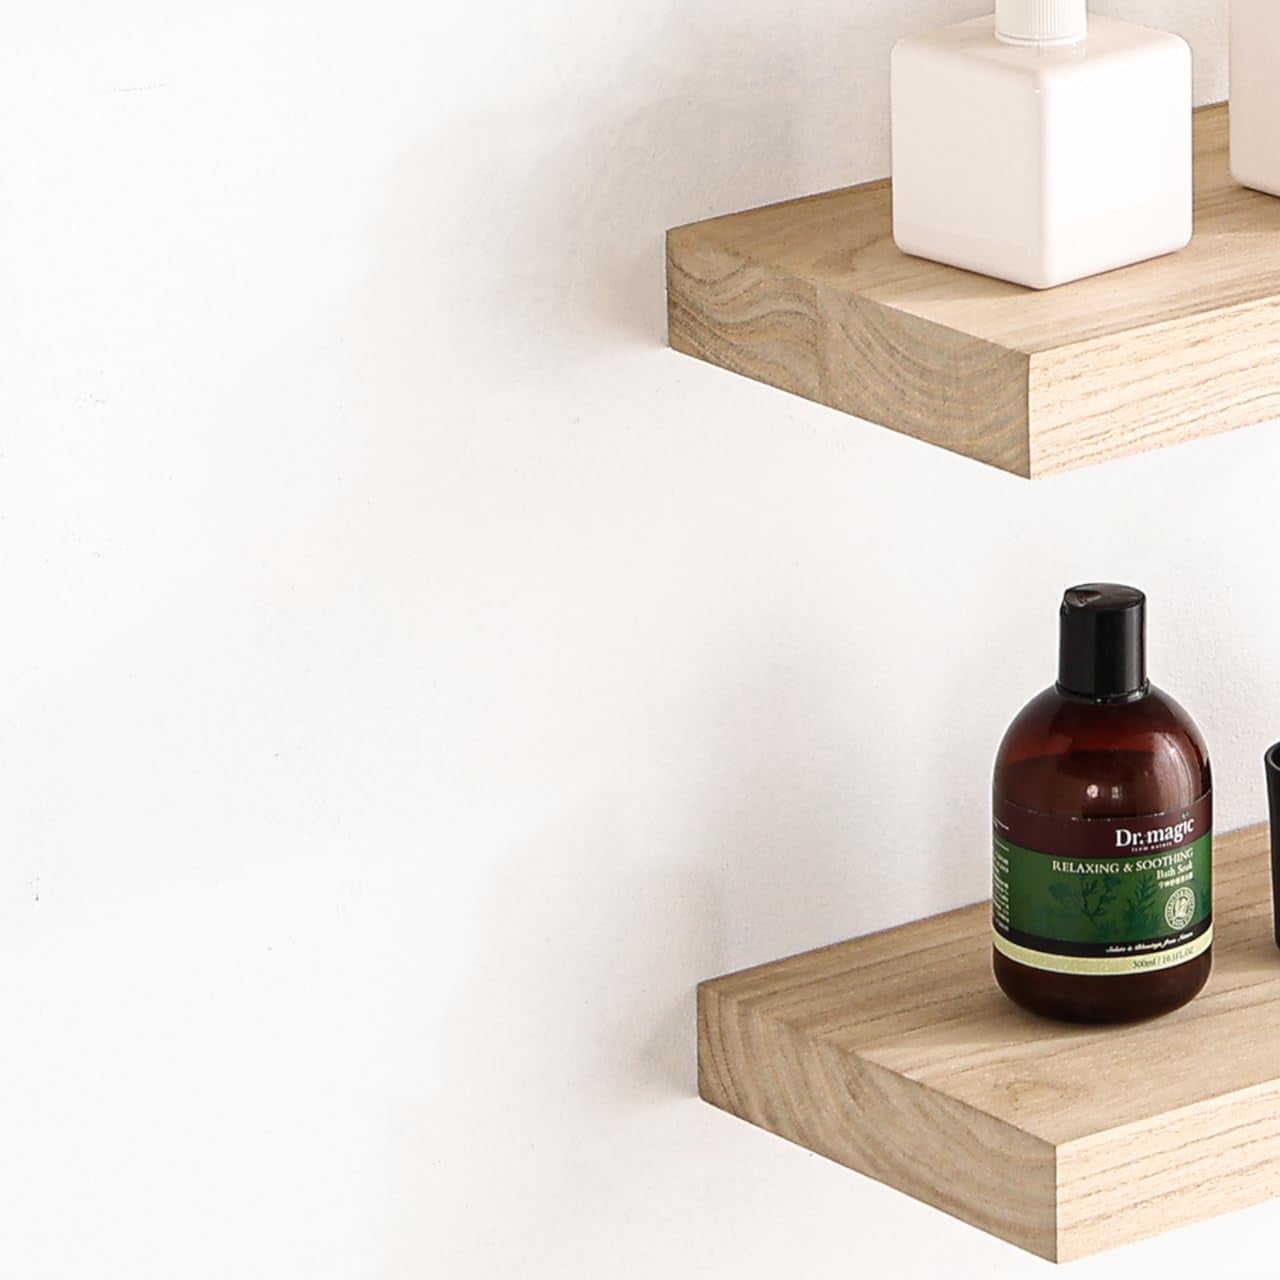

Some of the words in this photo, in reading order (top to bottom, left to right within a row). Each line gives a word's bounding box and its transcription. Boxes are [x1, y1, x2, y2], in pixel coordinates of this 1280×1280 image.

[1052, 860, 1119, 874] RELAXING
[1123, 863, 1134, 873] &
[1135, 847, 1194, 872] SOOTHING
[1156, 866, 1176, 880] Bath
[1131, 958, 1156, 969] 300ml
